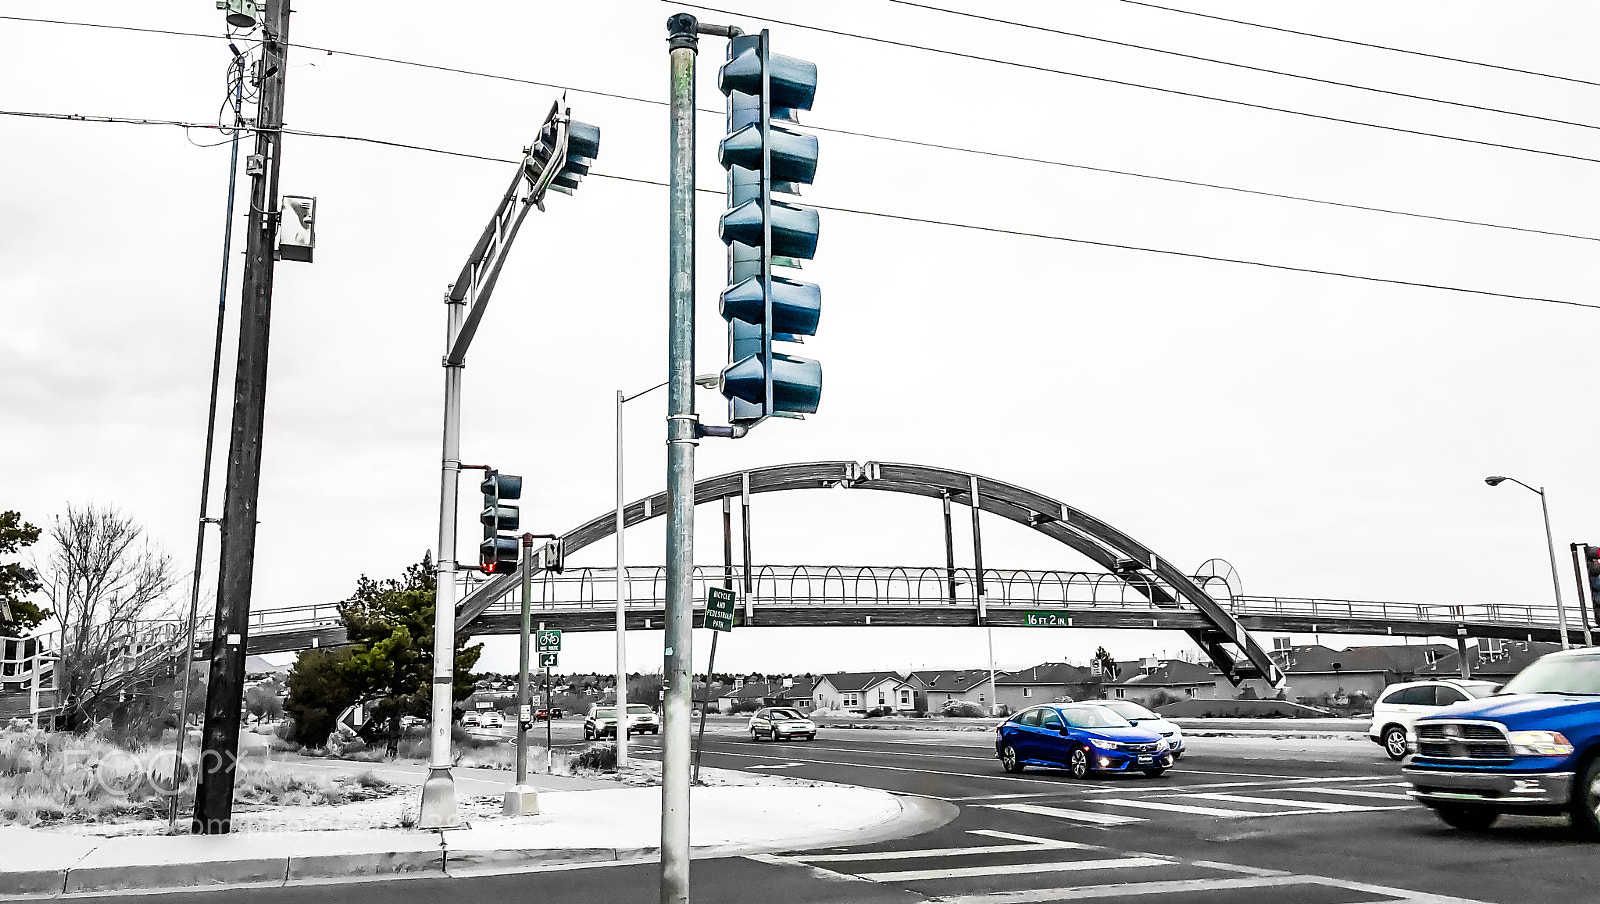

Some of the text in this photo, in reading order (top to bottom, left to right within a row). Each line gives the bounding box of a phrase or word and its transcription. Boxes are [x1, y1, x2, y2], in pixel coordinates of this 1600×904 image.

[713, 590, 731, 600] BICYCLE
[706, 609, 732, 620] PEDESTRIAN
[1028, 614, 1037, 624] 16
[1050, 614, 1056, 624] 2
[712, 620, 724, 628] PATH
